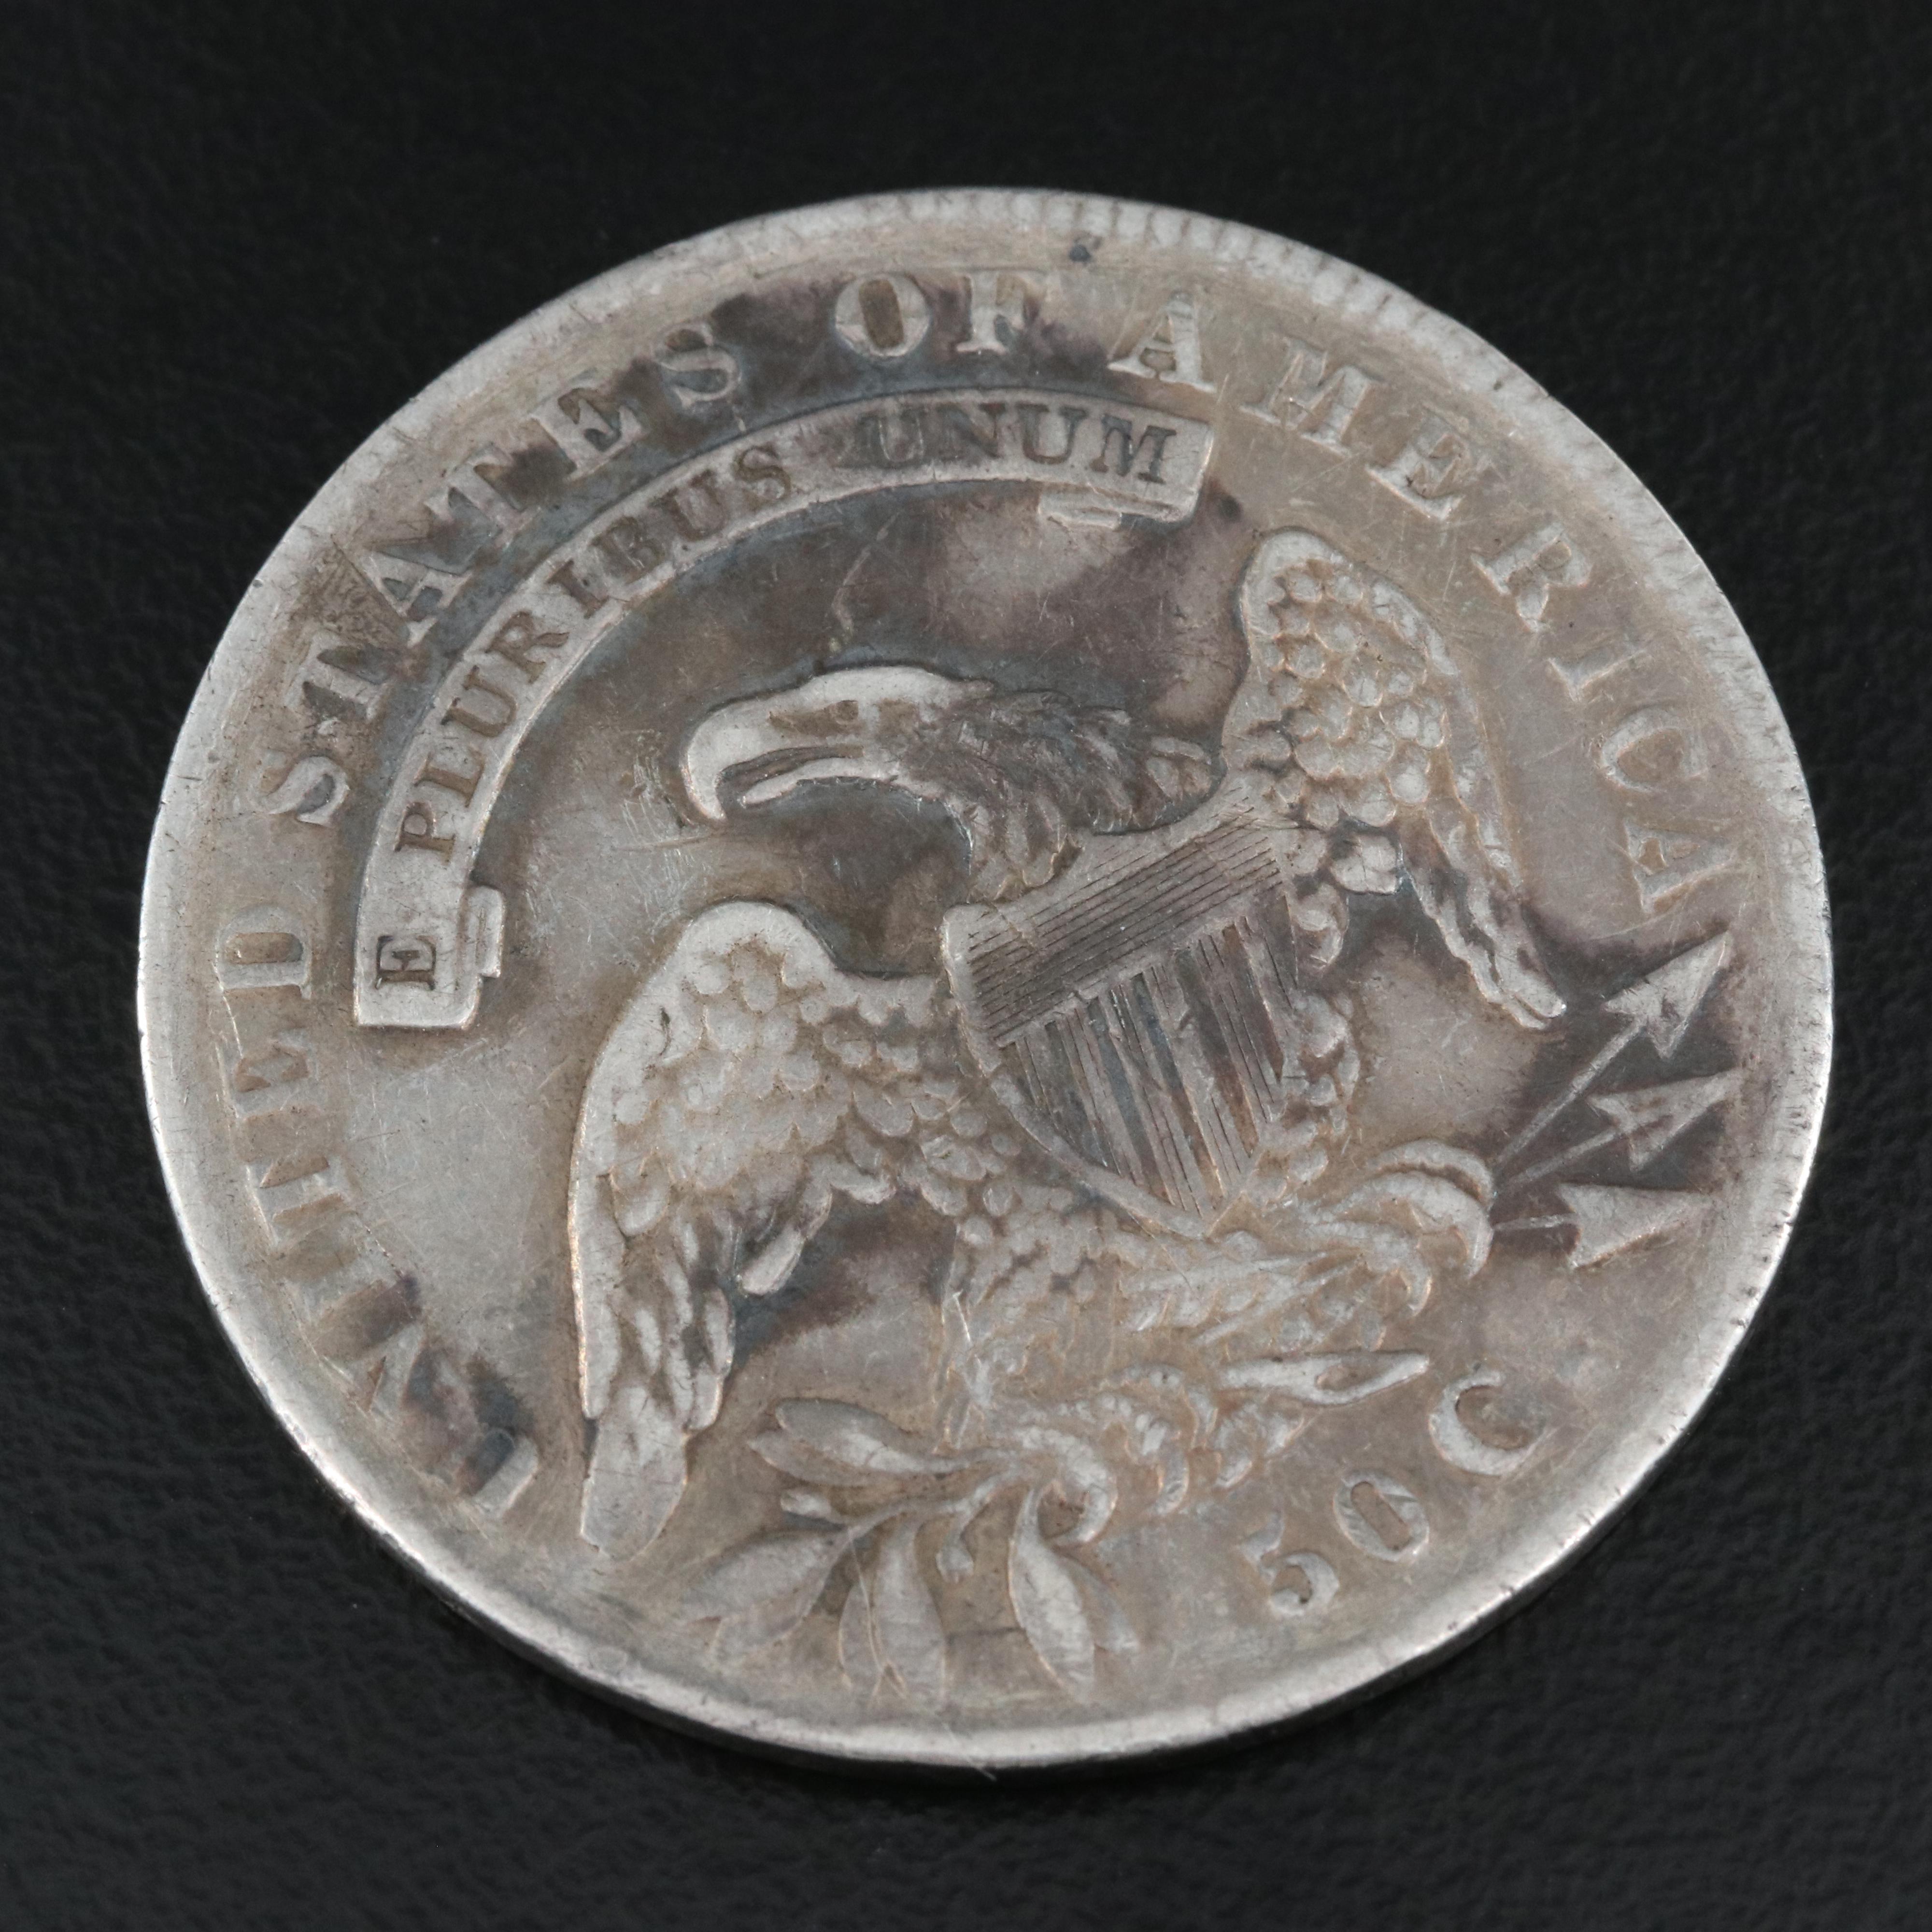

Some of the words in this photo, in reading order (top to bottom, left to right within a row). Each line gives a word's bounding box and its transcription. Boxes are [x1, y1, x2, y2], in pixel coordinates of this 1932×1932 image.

[857, 402, 1177, 484] UNUM
[249, 321, 744, 827] STATES
[834, 271, 1046, 358] OF
[1108, 290, 1739, 915] AMERICA
[393, 443, 793, 866] PLURIBUS
[375, 934, 438, 991] E
[1237, 1469, 1431, 1617] 50
